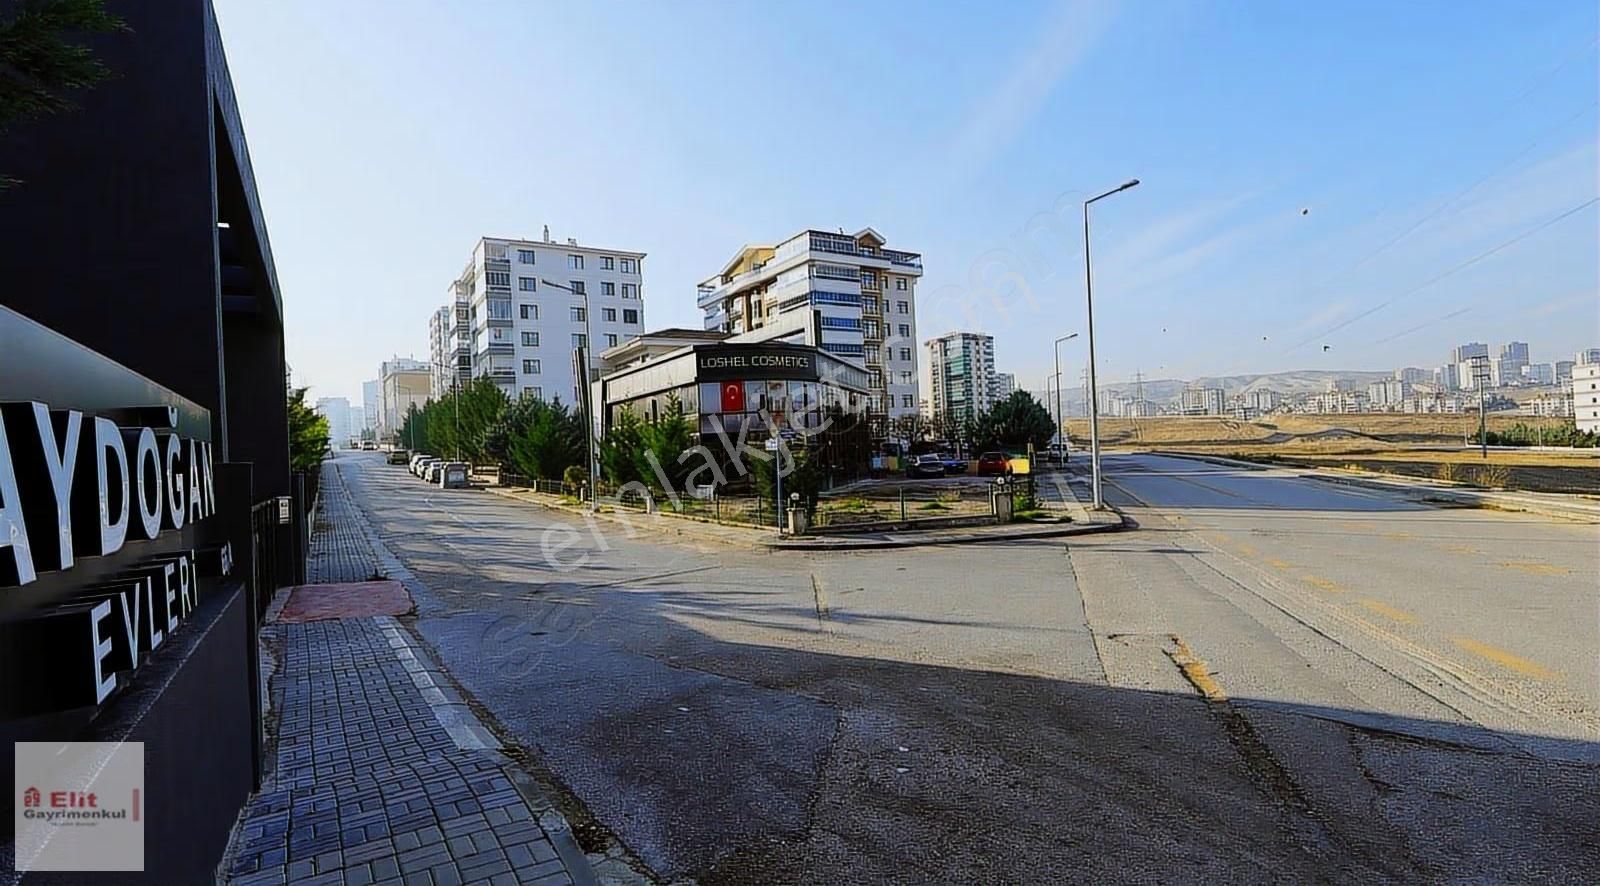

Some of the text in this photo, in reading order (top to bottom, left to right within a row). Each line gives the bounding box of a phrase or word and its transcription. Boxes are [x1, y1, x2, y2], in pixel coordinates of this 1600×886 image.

[700, 355, 809, 369] LOSHEL COSMETICS
[91, 548, 198, 705] EVLERİ
